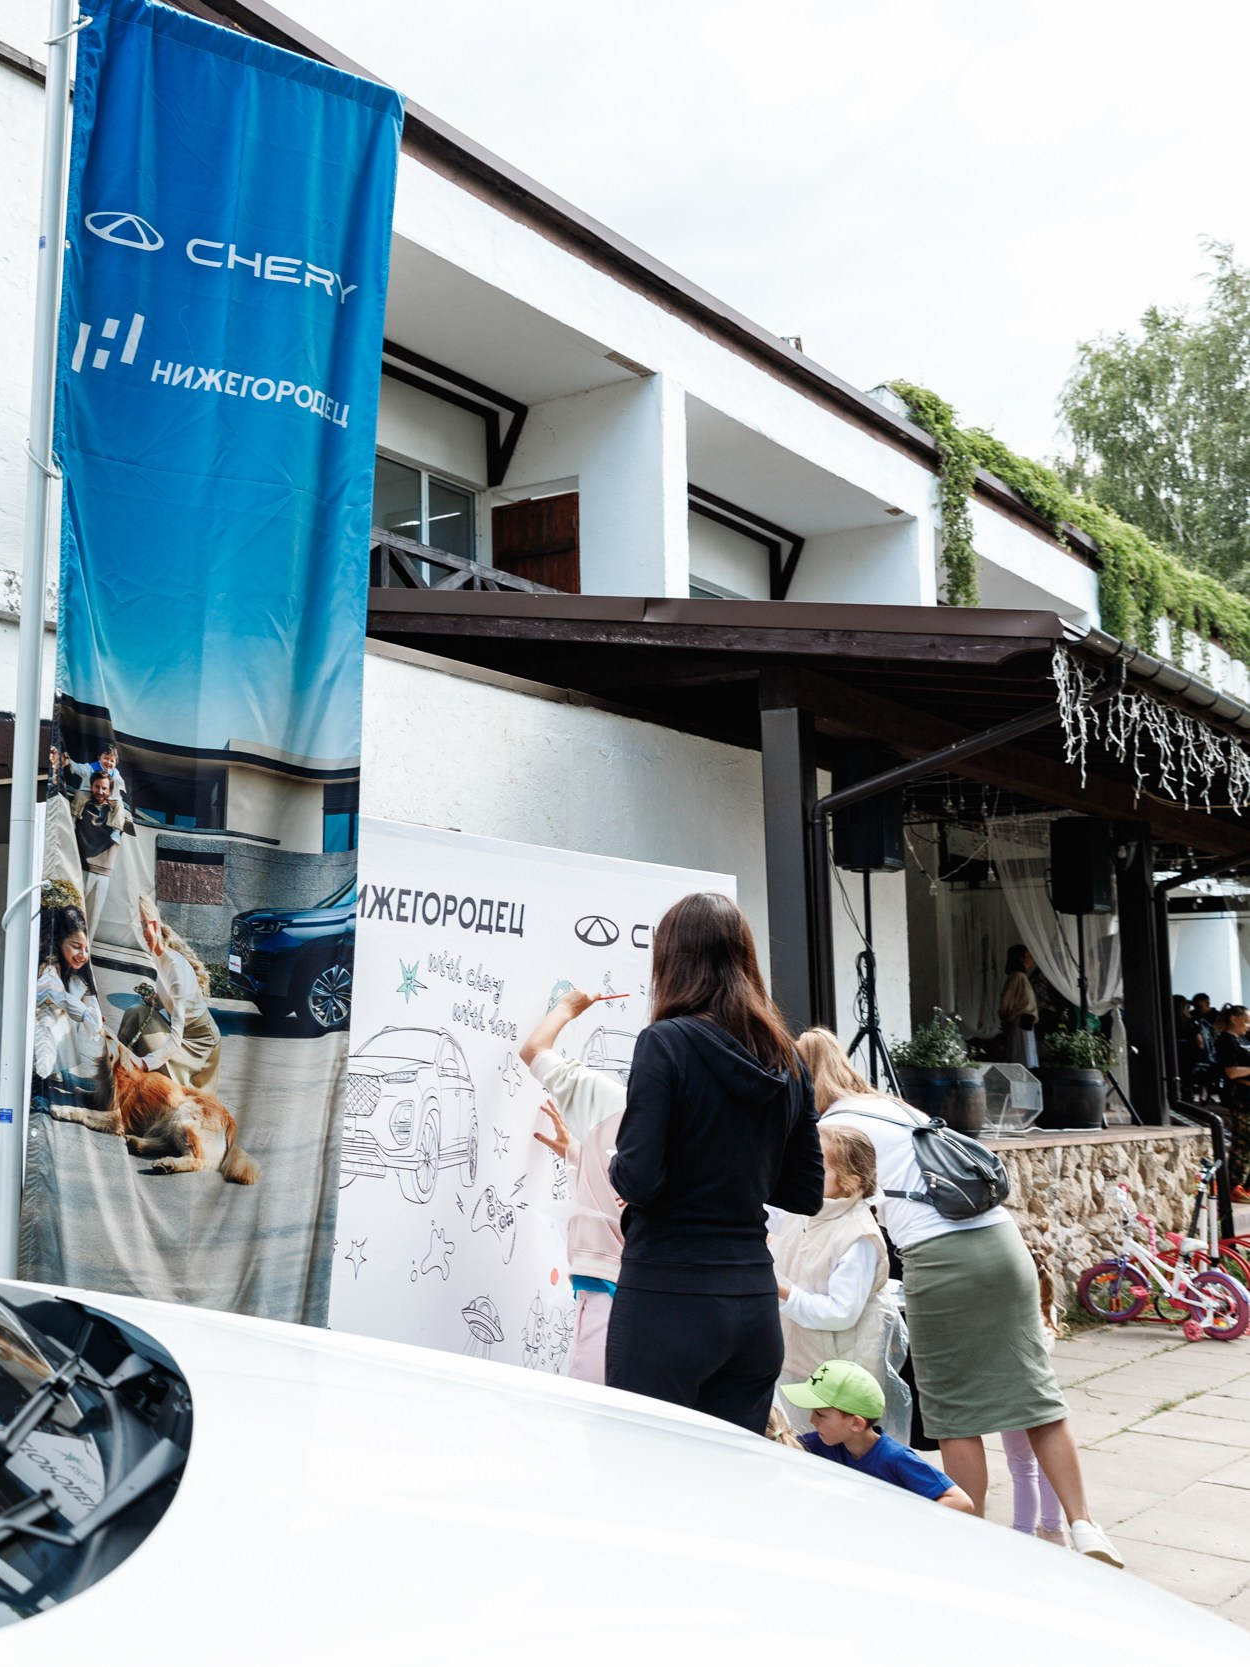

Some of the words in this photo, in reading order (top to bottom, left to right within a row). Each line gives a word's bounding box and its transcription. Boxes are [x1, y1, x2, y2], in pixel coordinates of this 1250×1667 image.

[186, 238, 358, 304] CHERY
[150, 359, 350, 428] НИЖЕГОРОДЕЦ
[357, 884, 525, 938] ИЖЕГОРОДЕЦ
[427, 950, 462, 984] with
[466, 963, 505, 1005] chery
[452, 999, 486, 1032] with
[488, 1007, 518, 1041] love
